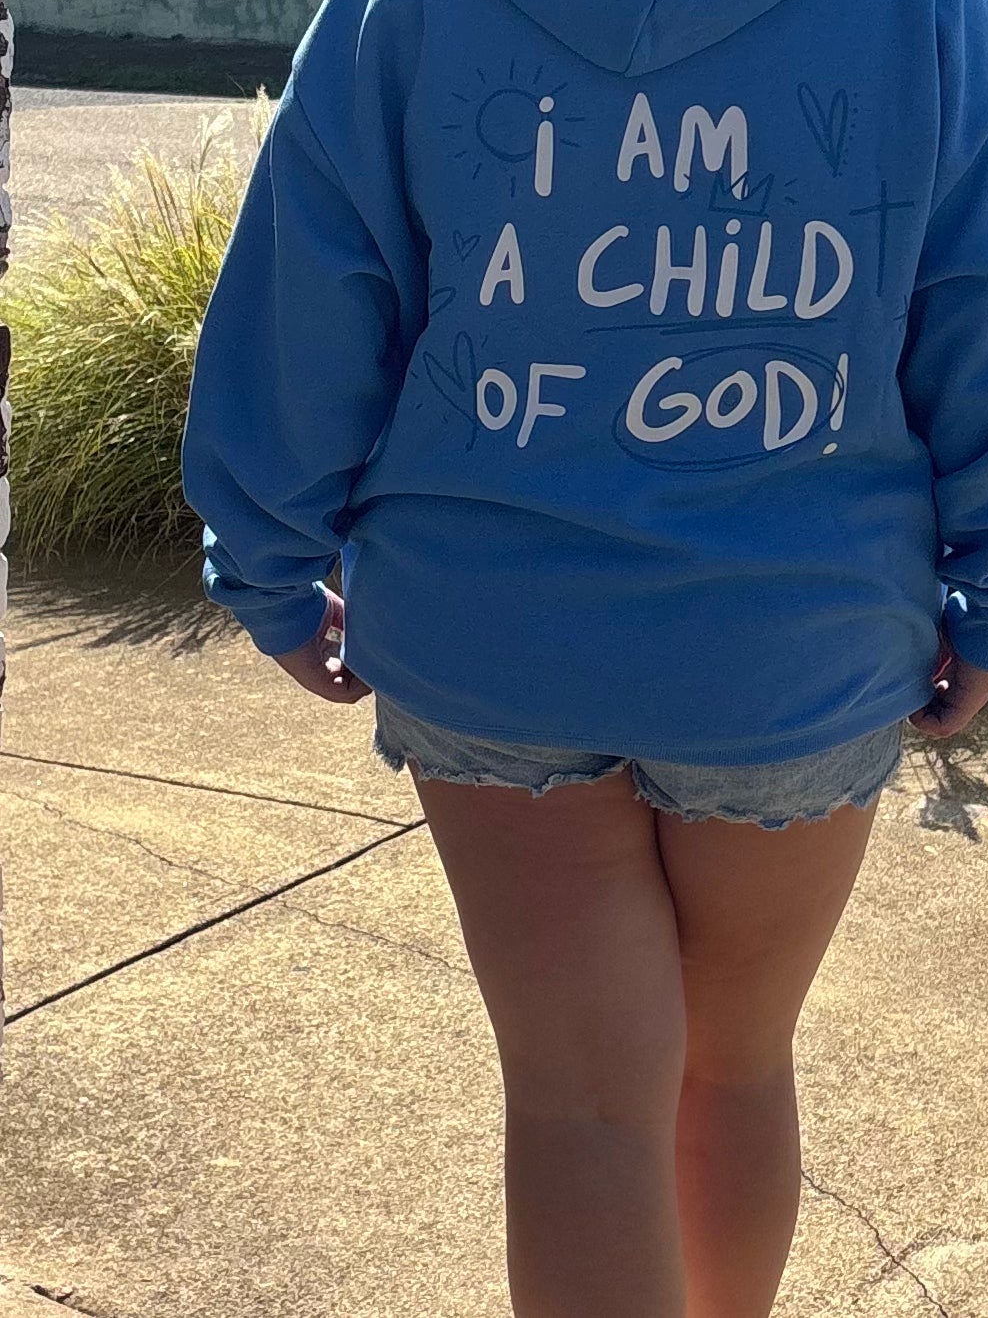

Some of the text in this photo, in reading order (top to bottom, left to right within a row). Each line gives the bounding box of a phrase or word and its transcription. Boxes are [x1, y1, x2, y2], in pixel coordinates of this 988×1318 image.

[616, 92, 749, 200] AM
[479, 222, 525, 307] A
[476, 362, 586, 449] OF
